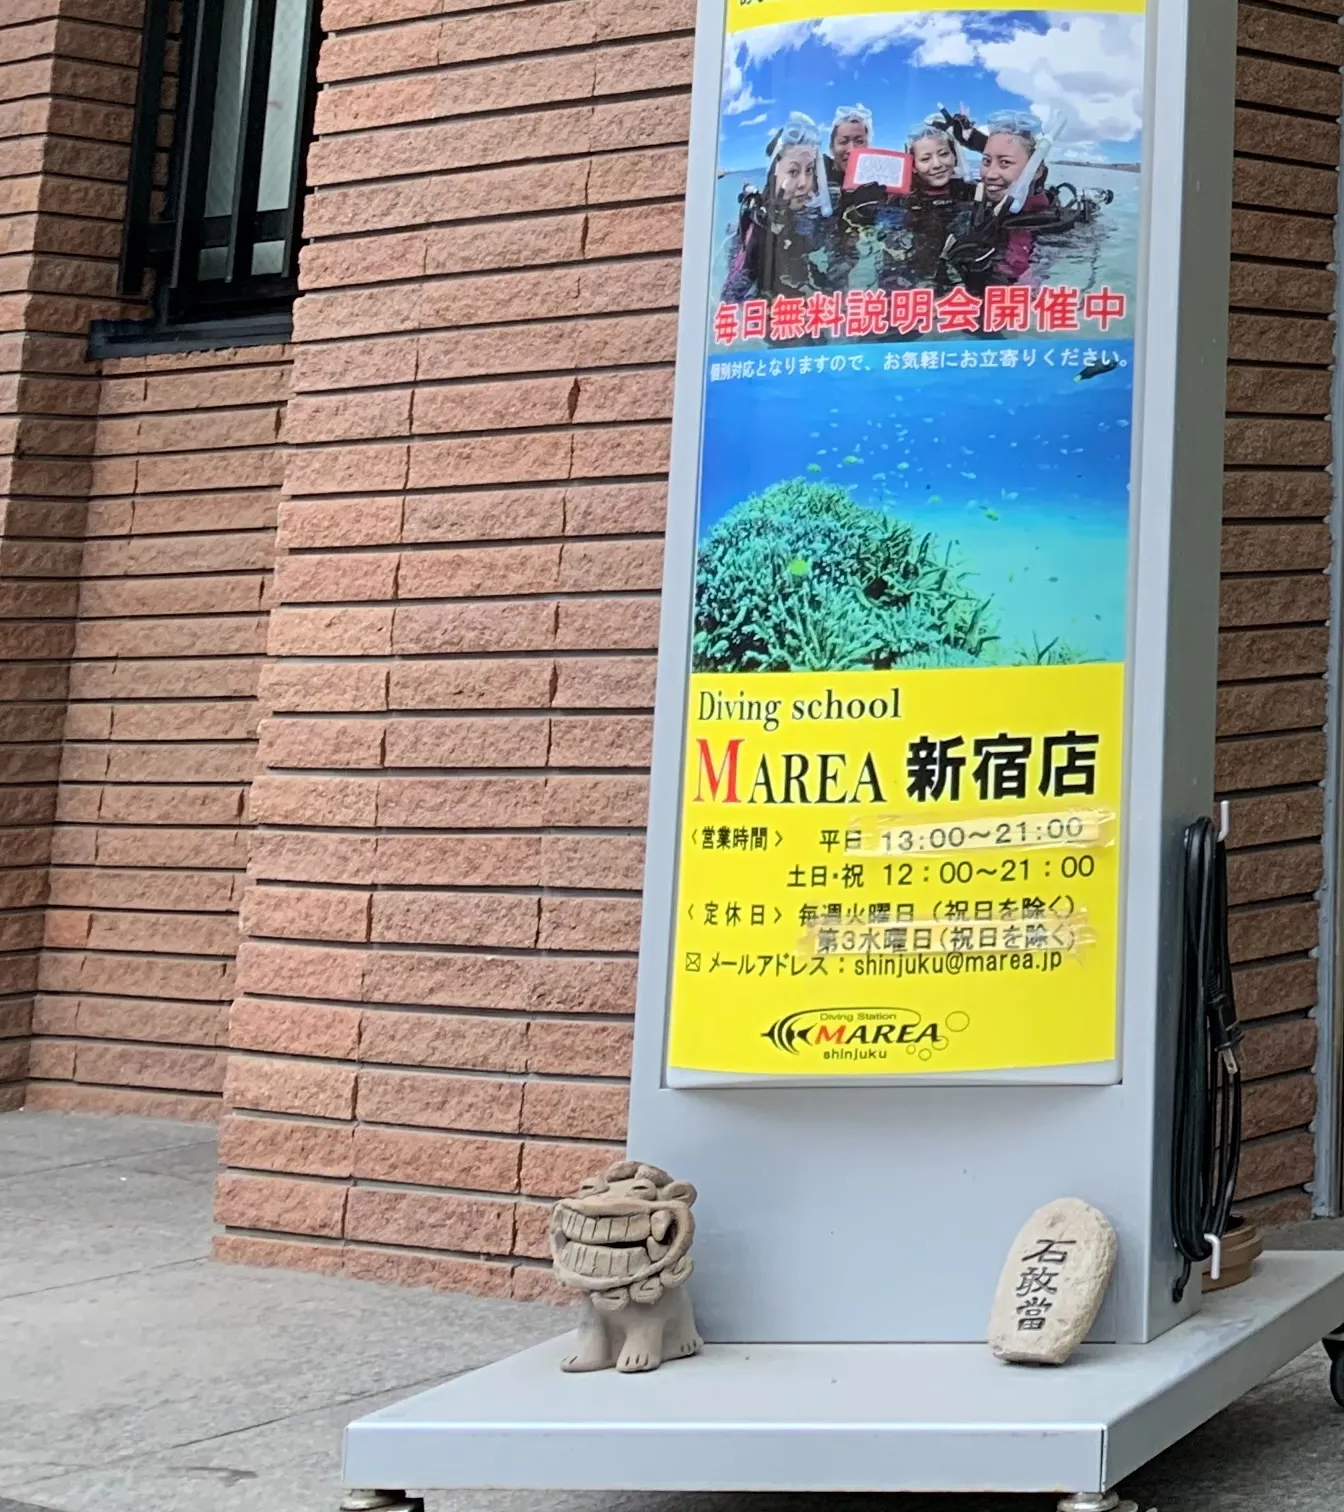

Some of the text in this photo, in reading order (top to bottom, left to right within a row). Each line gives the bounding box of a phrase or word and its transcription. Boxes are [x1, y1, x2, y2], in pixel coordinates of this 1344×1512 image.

[713, 285, 1127, 345] 毎日無料説明会開催中
[698, 687, 902, 731] Diving school
[692, 730, 1100, 805] MAREA 新宿店
[819, 829, 862, 853] 平日
[820, 1012, 897, 1022] Diving Station
[814, 1023, 939, 1045] MAREA
[823, 1047, 887, 1060] shinjuku
